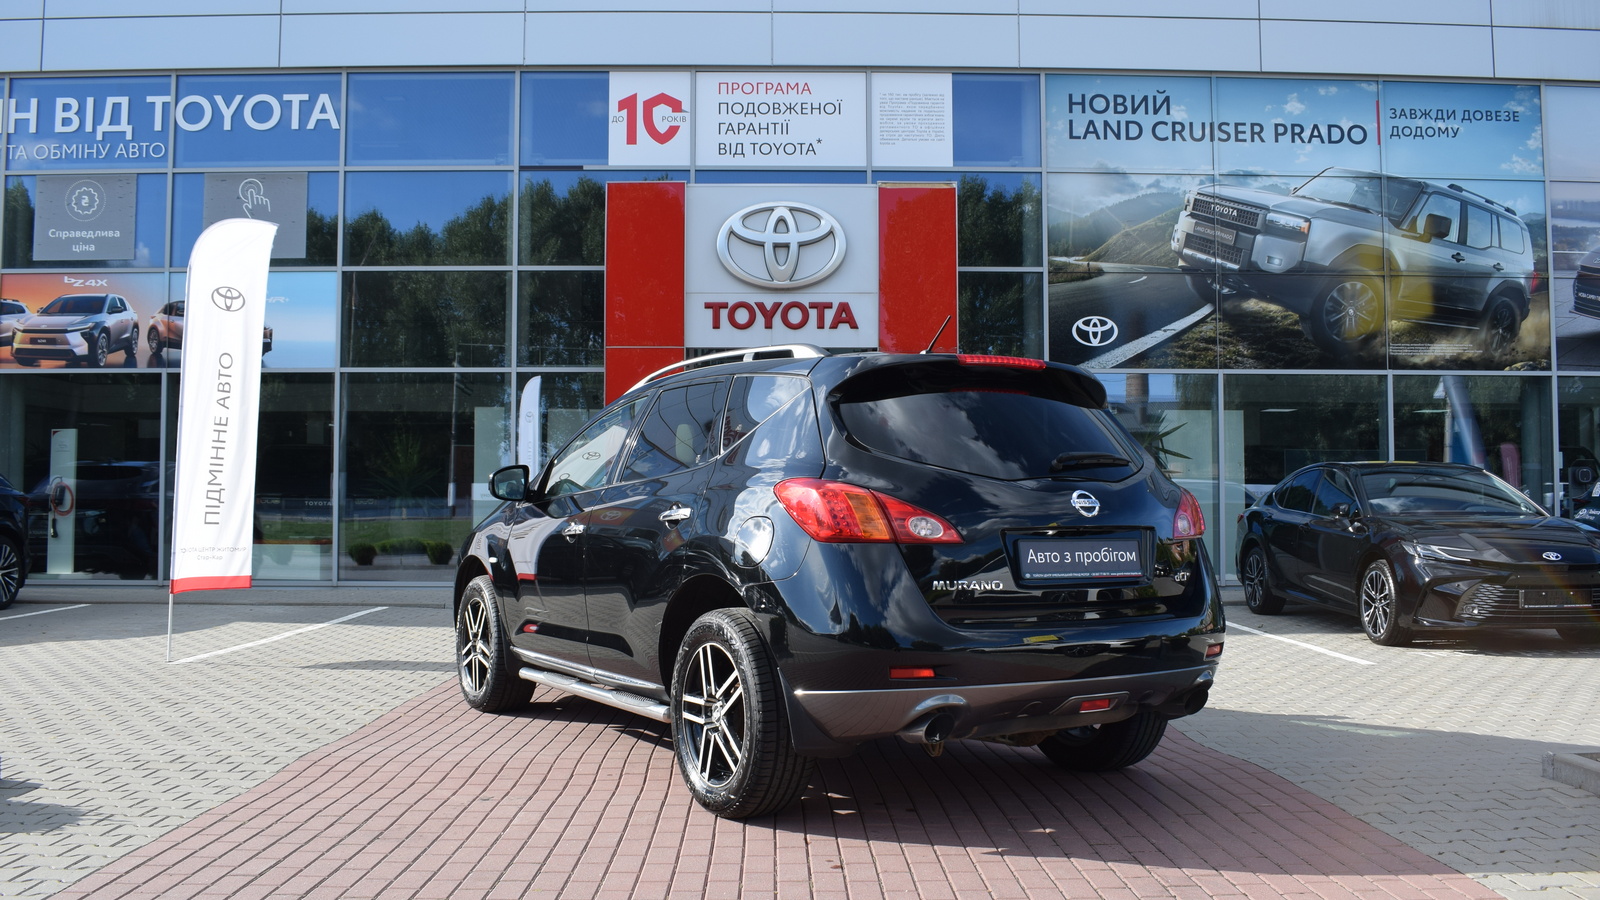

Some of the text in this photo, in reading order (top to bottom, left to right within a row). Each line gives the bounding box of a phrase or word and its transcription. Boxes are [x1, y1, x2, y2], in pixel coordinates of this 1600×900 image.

[718, 82, 812, 95] ПРОГРАМА
[718, 99, 842, 118] ПОДОВЖЕНОЇ
[1068, 90, 1171, 116] НОВИЙ
[55, 97, 134, 140] ВІД
[146, 93, 340, 132] TOYOTA
[612, 115, 625, 124] ДО
[661, 115, 687, 123] РОКІВ
[1389, 107, 1520, 124] ЗАВЖДИ ДОВЕЗЕ
[718, 119, 790, 136] ГАРАНТІЇ
[1068, 119, 1368, 145] LAND CRUISER PRADO
[1389, 125, 1460, 140] ДОДОМУ
[6, 142, 166, 160] ТА ОБМІНУ АВТО
[718, 142, 745, 158] ВІД
[1211, 204, 1237, 216] TOYOTA
[48, 228, 121, 240] Справедлива
[72, 243, 96, 255] ціна
[704, 301, 859, 330] TOYOTA
[204, 352, 234, 525] ПІДМІННЕ АВТО
[1027, 546, 1137, 566] Авто з пробігом
[932, 580, 1003, 591] MURANO
